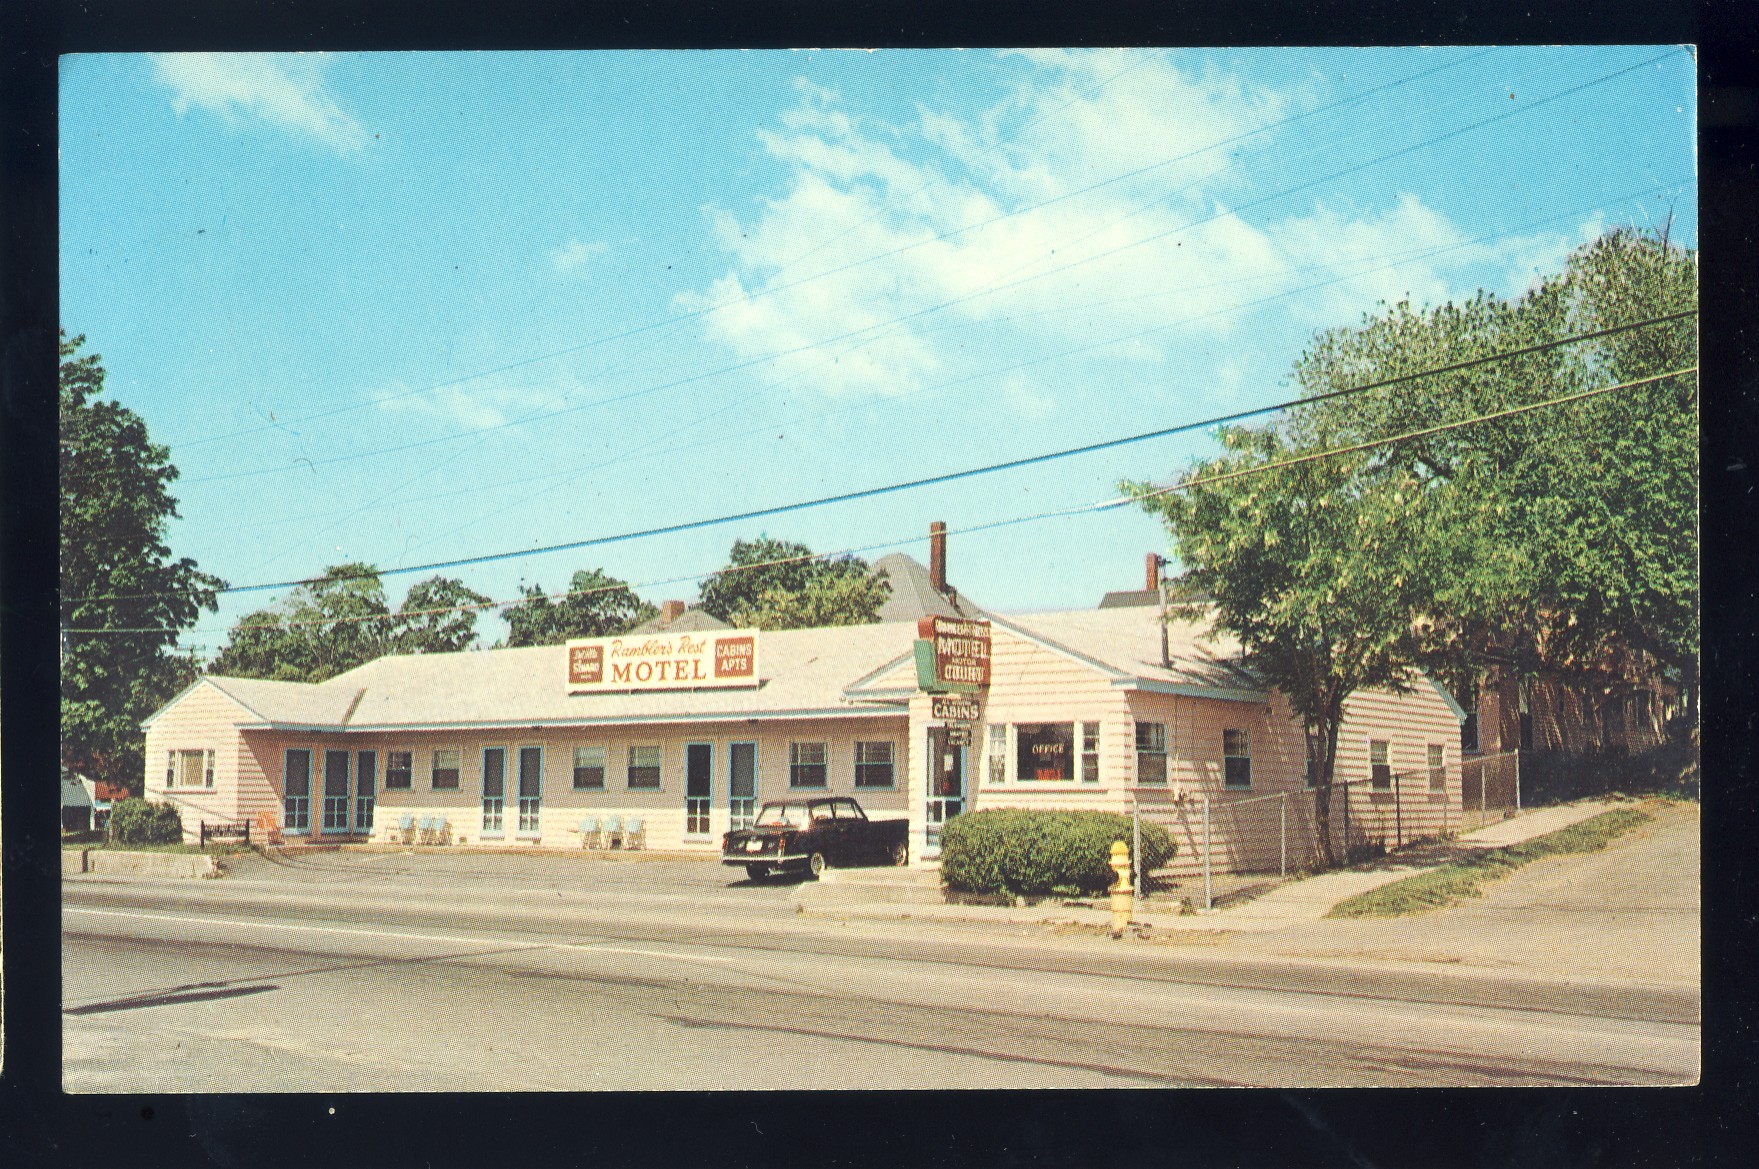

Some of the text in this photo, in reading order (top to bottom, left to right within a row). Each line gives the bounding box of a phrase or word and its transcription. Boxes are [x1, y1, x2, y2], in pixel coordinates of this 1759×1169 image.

[678, 635, 707, 655] Rest
[716, 643, 753, 658] CABINS
[937, 637, 989, 659] MOTEL
[611, 659, 707, 683] MOTEL
[721, 658, 747, 672] APTS
[944, 665, 985, 682] COURT
[933, 703, 979, 720] CABINS
[1032, 743, 1064, 755] OFFICE
